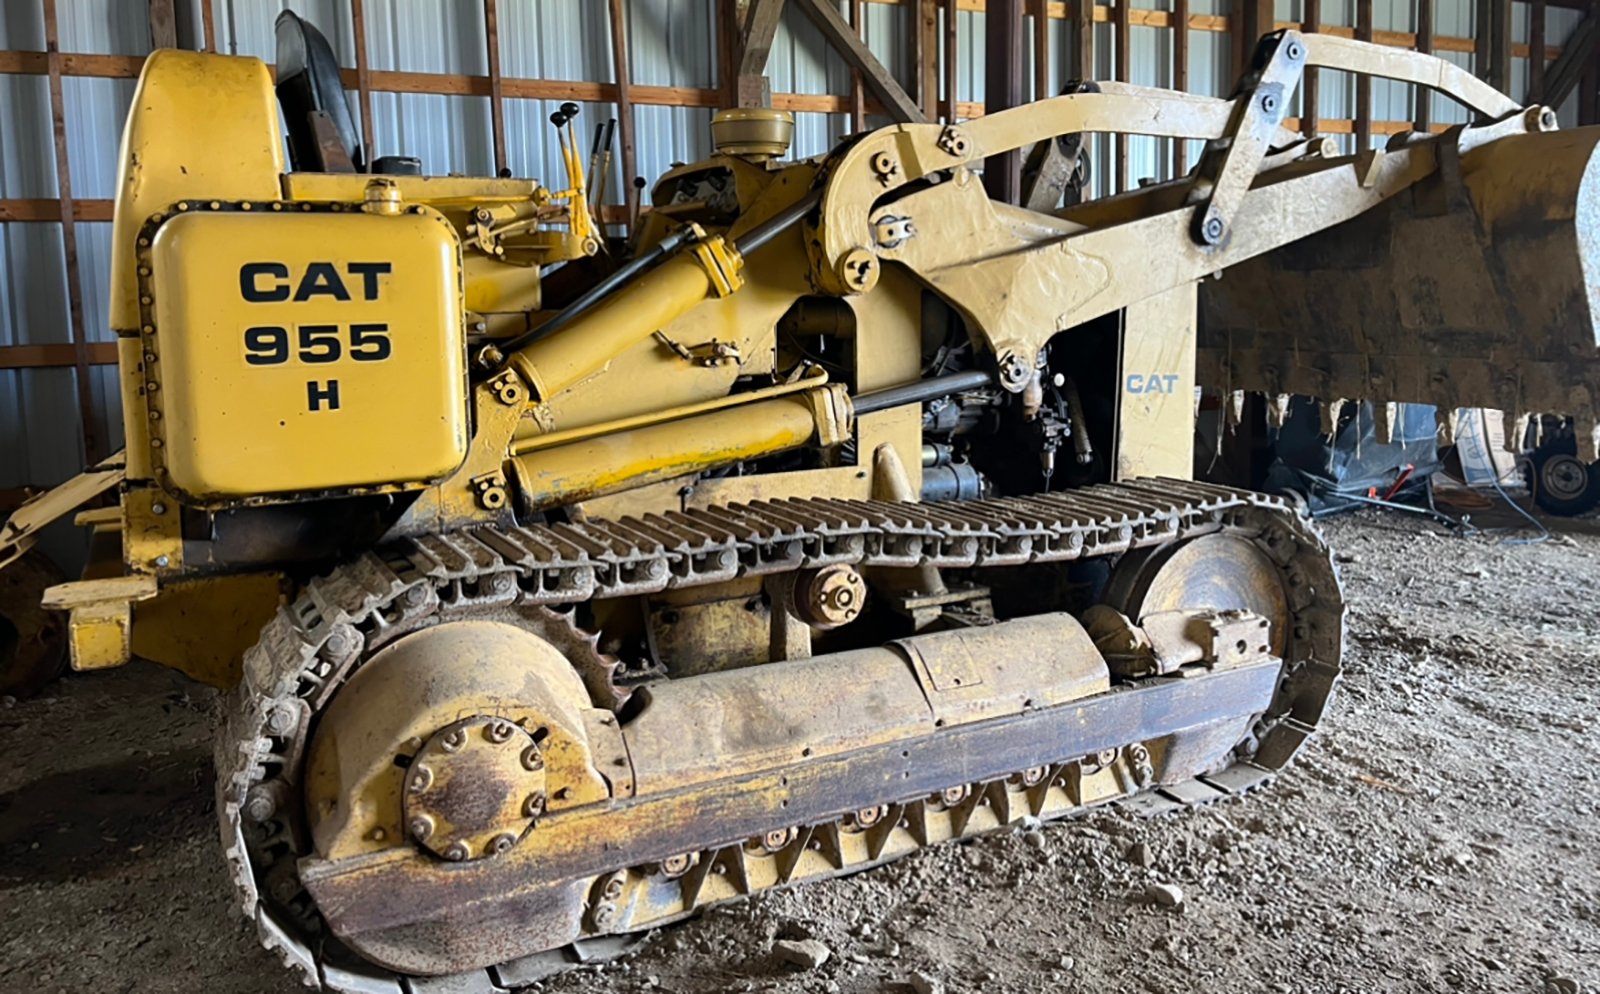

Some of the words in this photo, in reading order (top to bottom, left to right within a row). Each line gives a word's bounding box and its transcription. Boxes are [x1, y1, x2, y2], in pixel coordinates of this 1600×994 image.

[240, 262, 391, 302] CAT
[245, 324, 391, 365] 955
[307, 380, 339, 411] H
[1126, 374, 1178, 393] CAT
